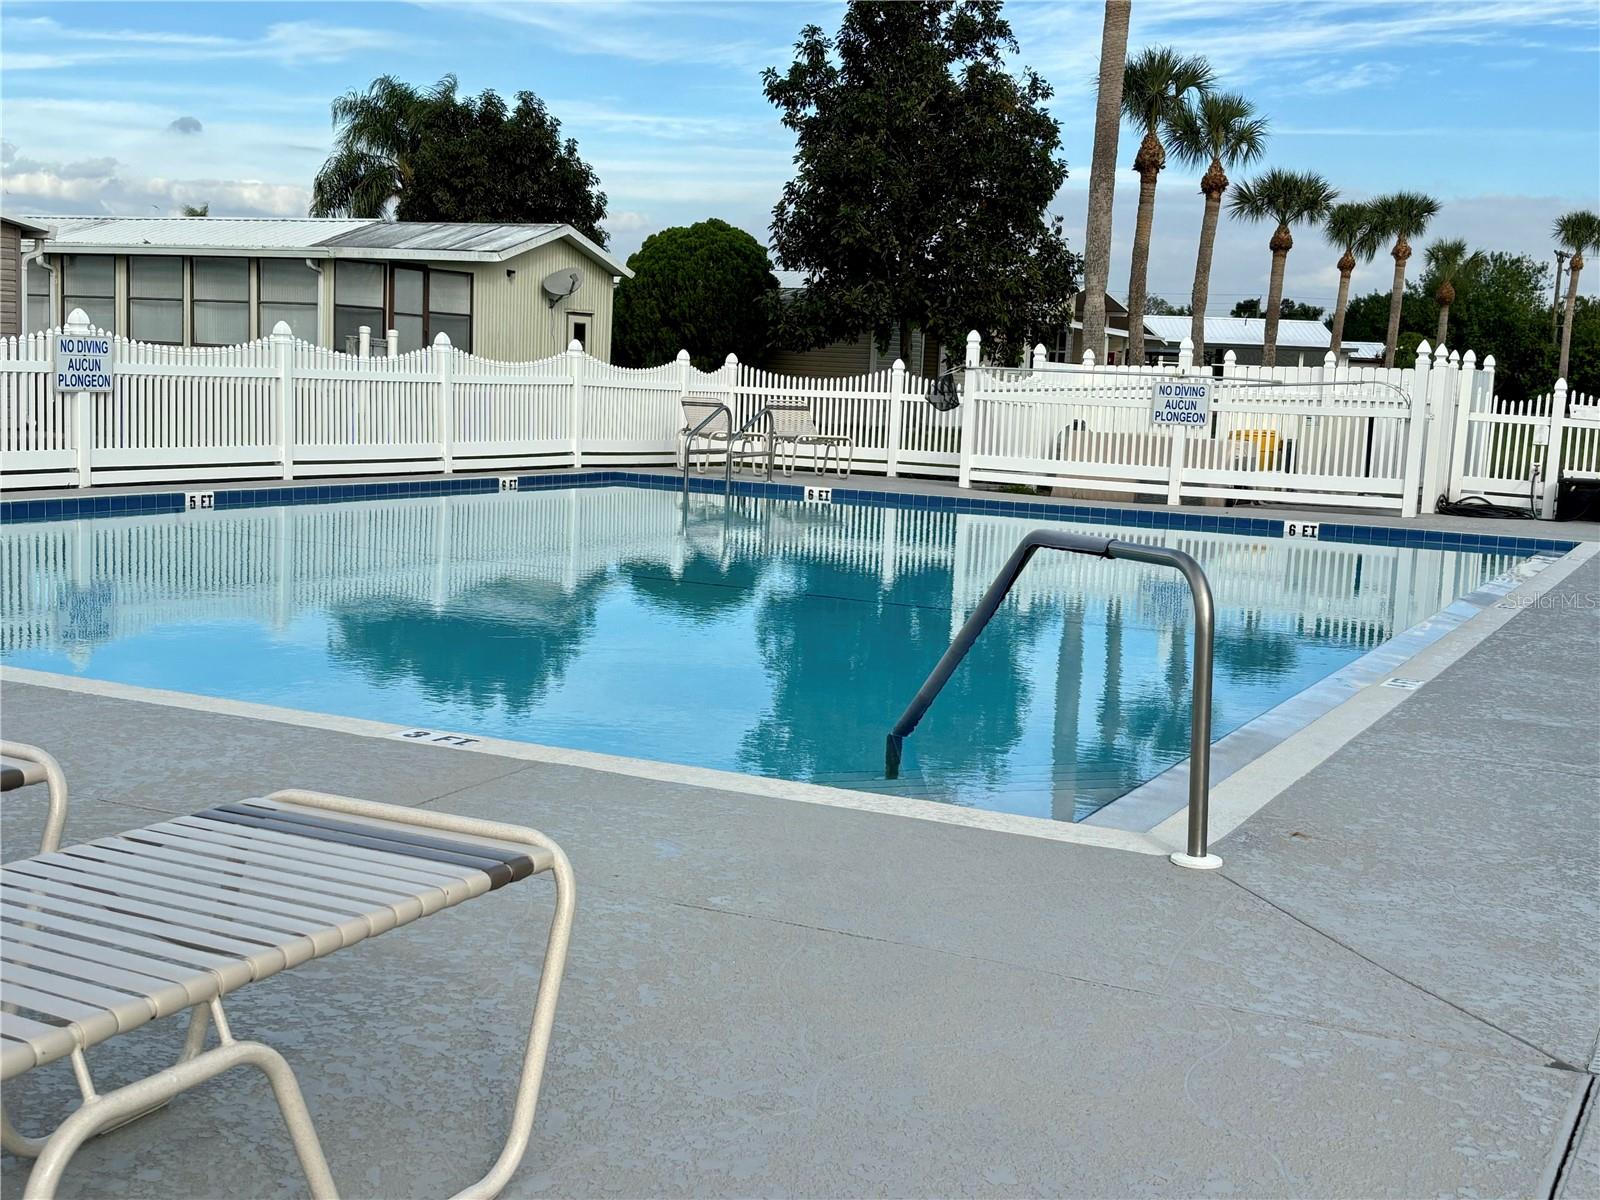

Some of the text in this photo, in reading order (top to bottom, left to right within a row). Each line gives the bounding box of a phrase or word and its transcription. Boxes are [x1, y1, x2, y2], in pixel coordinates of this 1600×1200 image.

[60, 339, 109, 354] NO DIVING
[67, 358, 102, 372] AUCUN
[58, 373, 111, 388] PLONGEON
[1159, 385, 1206, 398] NO DIVING
[1164, 399, 1198, 411] AUCUN
[1154, 410, 1206, 424] PLONGEON
[807, 488, 815, 501] 6
[189, 495, 196, 510] 5
[1288, 523, 1297, 537] 6
